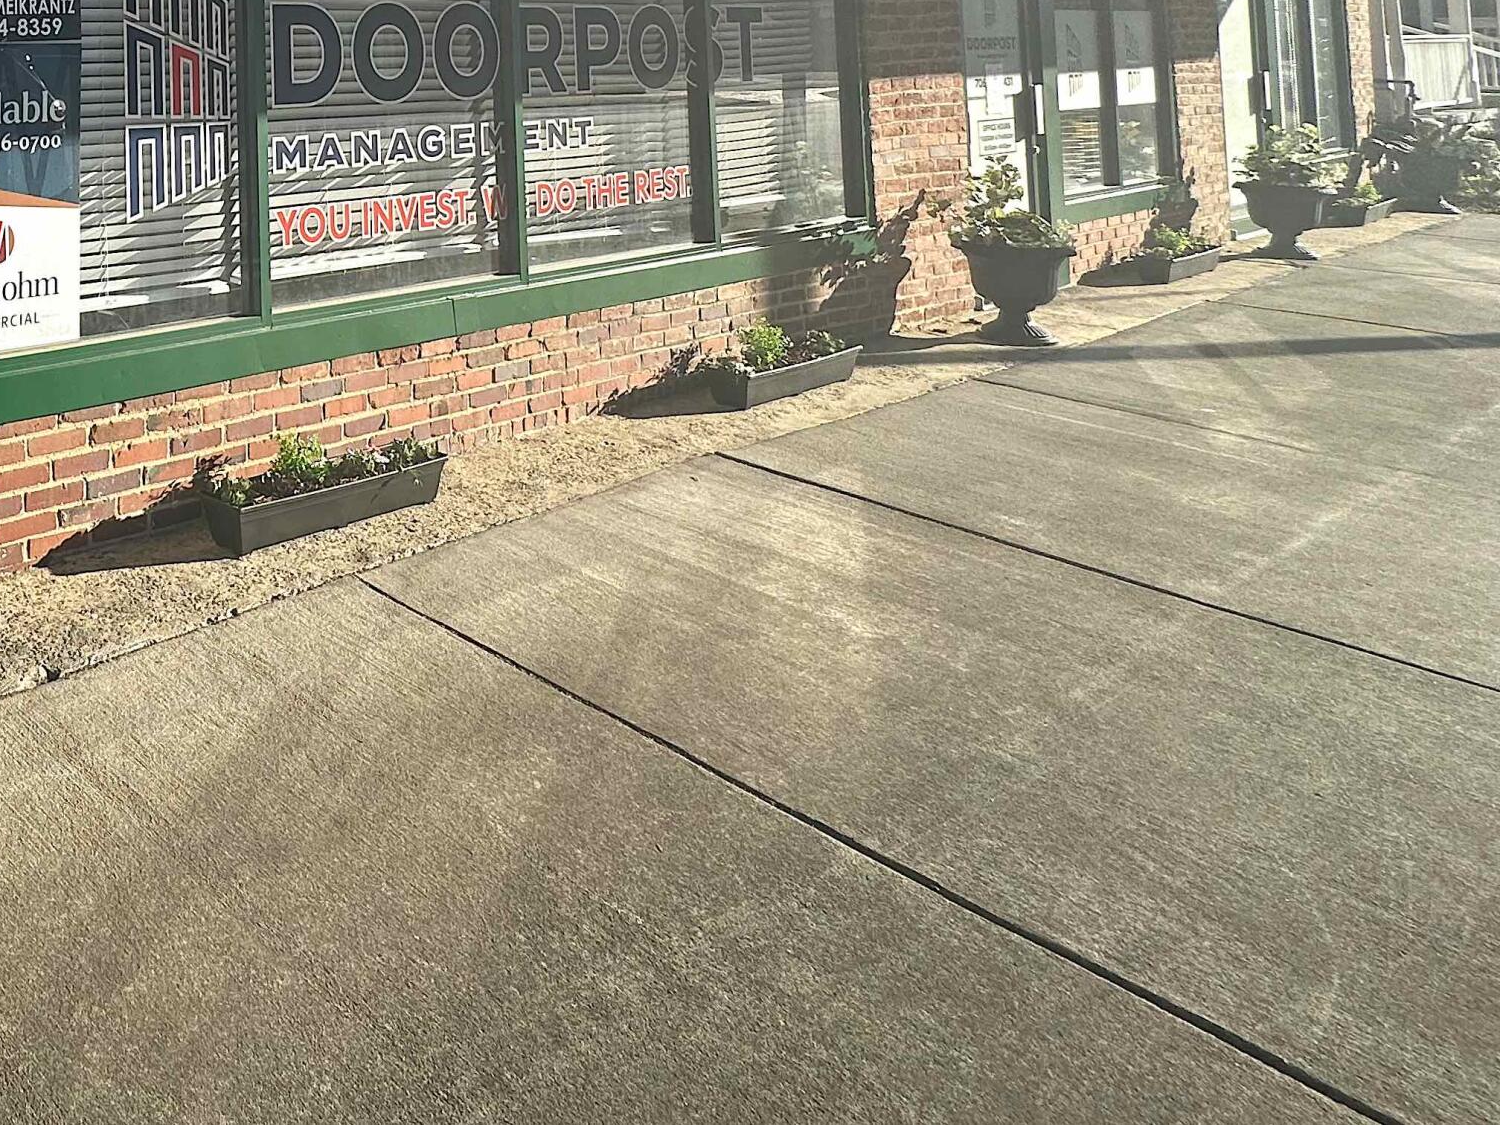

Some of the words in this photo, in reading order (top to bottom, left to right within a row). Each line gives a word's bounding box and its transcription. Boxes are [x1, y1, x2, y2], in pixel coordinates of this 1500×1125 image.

[269, 0, 764, 109] DOORPOST
[271, 116, 594, 175] MANAGEMENT
[274, 202, 352, 249] YOU
[360, 188, 477, 239] INVEST.
[535, 177, 578, 217] DO
[581, 171, 630, 211] THE
[633, 164, 692, 204] REST.
